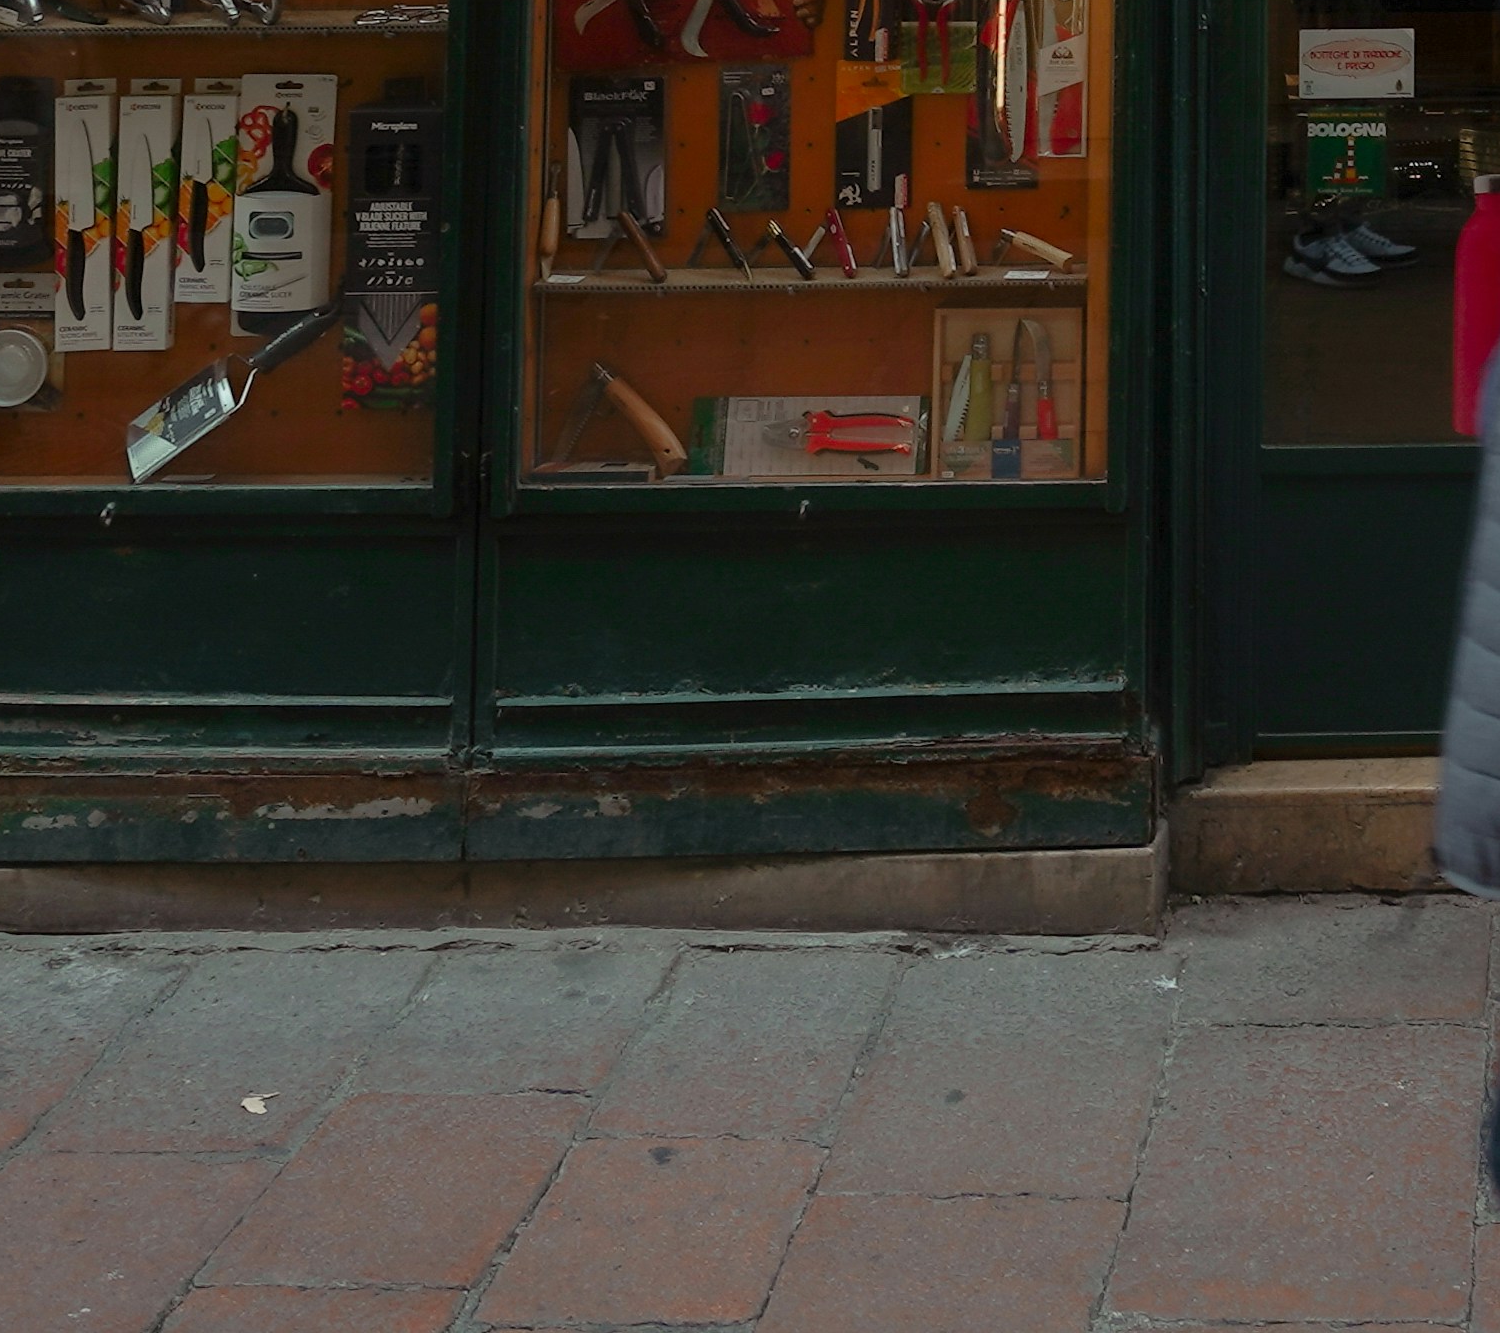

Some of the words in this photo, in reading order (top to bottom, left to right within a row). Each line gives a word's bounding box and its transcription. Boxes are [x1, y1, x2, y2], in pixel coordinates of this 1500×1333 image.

[848, 8, 861, 59] ALPEN
[1310, 50, 1350, 60] BOTTEGHE
[1307, 121, 1388, 138] BOLOGNA
[24, 290, 51, 301] Grater
